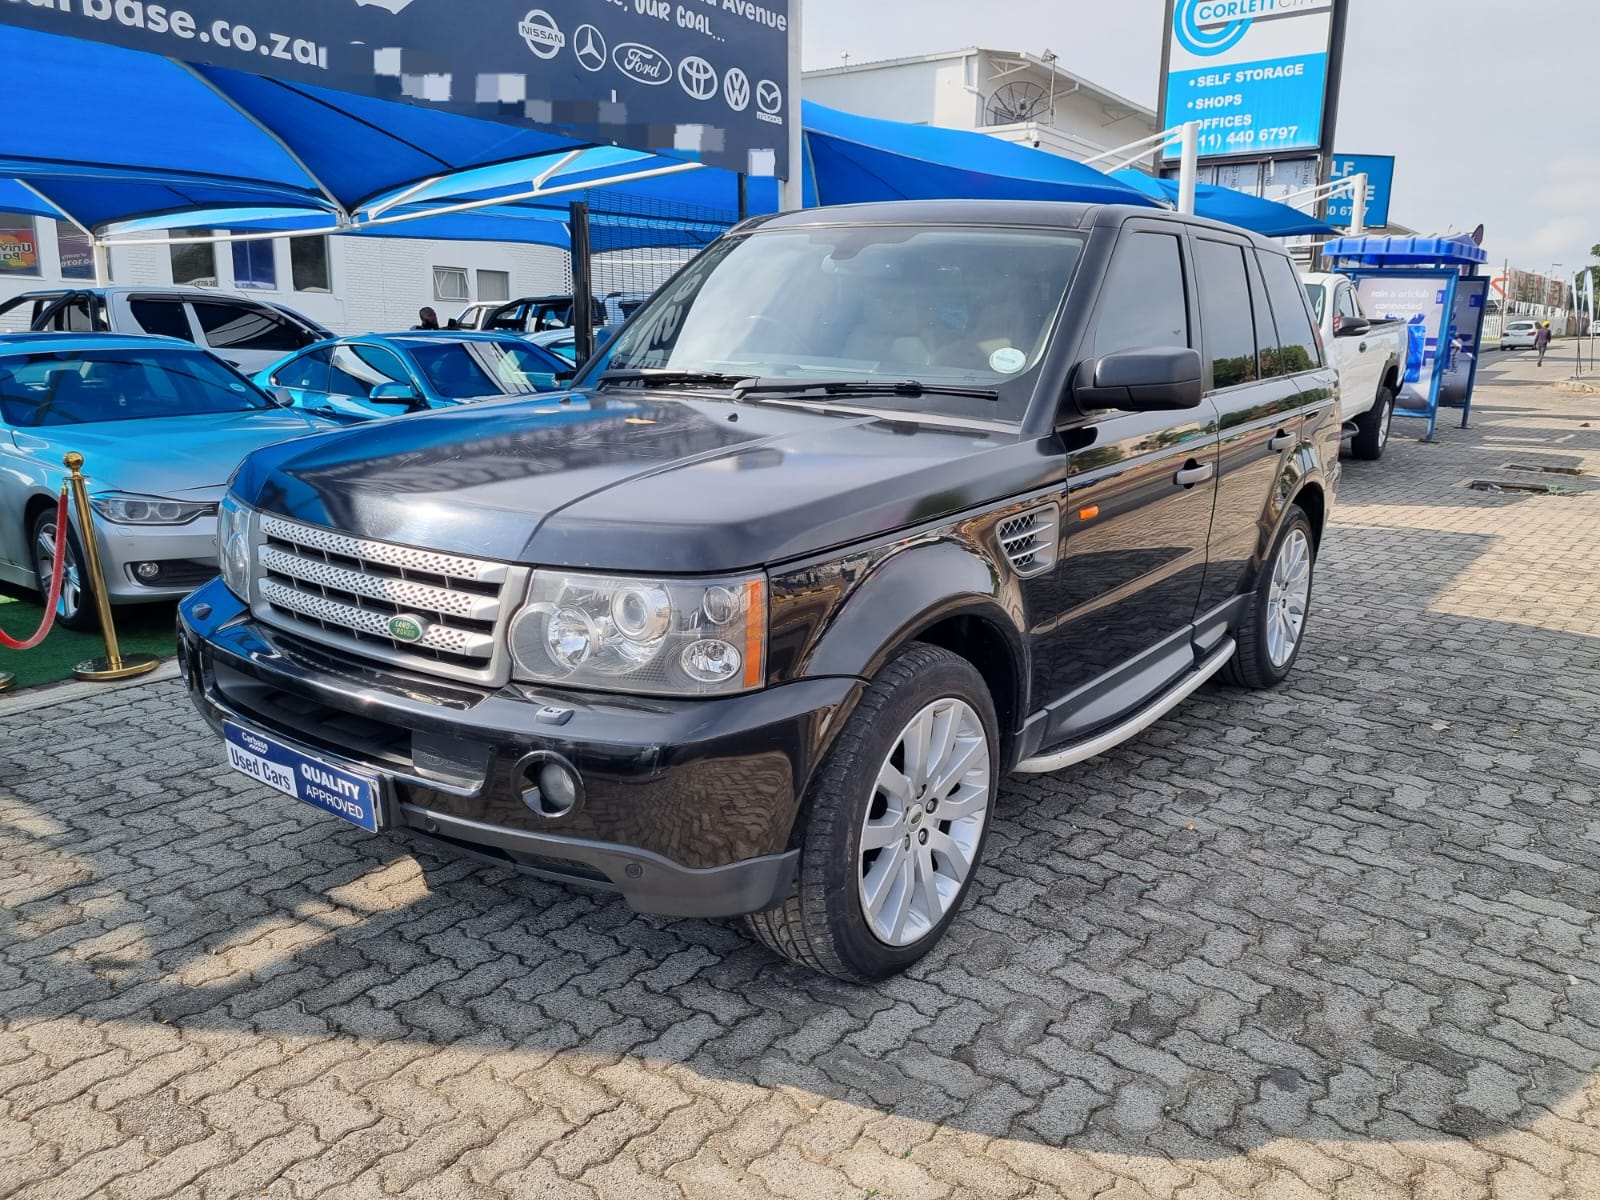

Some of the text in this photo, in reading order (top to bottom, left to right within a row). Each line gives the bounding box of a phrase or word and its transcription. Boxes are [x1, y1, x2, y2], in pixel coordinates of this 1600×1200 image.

[722, 0, 787, 31] Avenue
[8, 0, 318, 65] base.co.za
[521, 24, 563, 45] NISSAN
[623, 48, 662, 78] Ford
[1197, 64, 1304, 87] SELF STORAGE
[1195, 94, 1242, 110] SHOPS
[1226, 130, 1254, 144] 440
[1259, 126, 1298, 141] 6797
[230, 748, 291, 791] Used Cars
[301, 763, 360, 801] QUALITY
[306, 785, 364, 819] APPROVED
